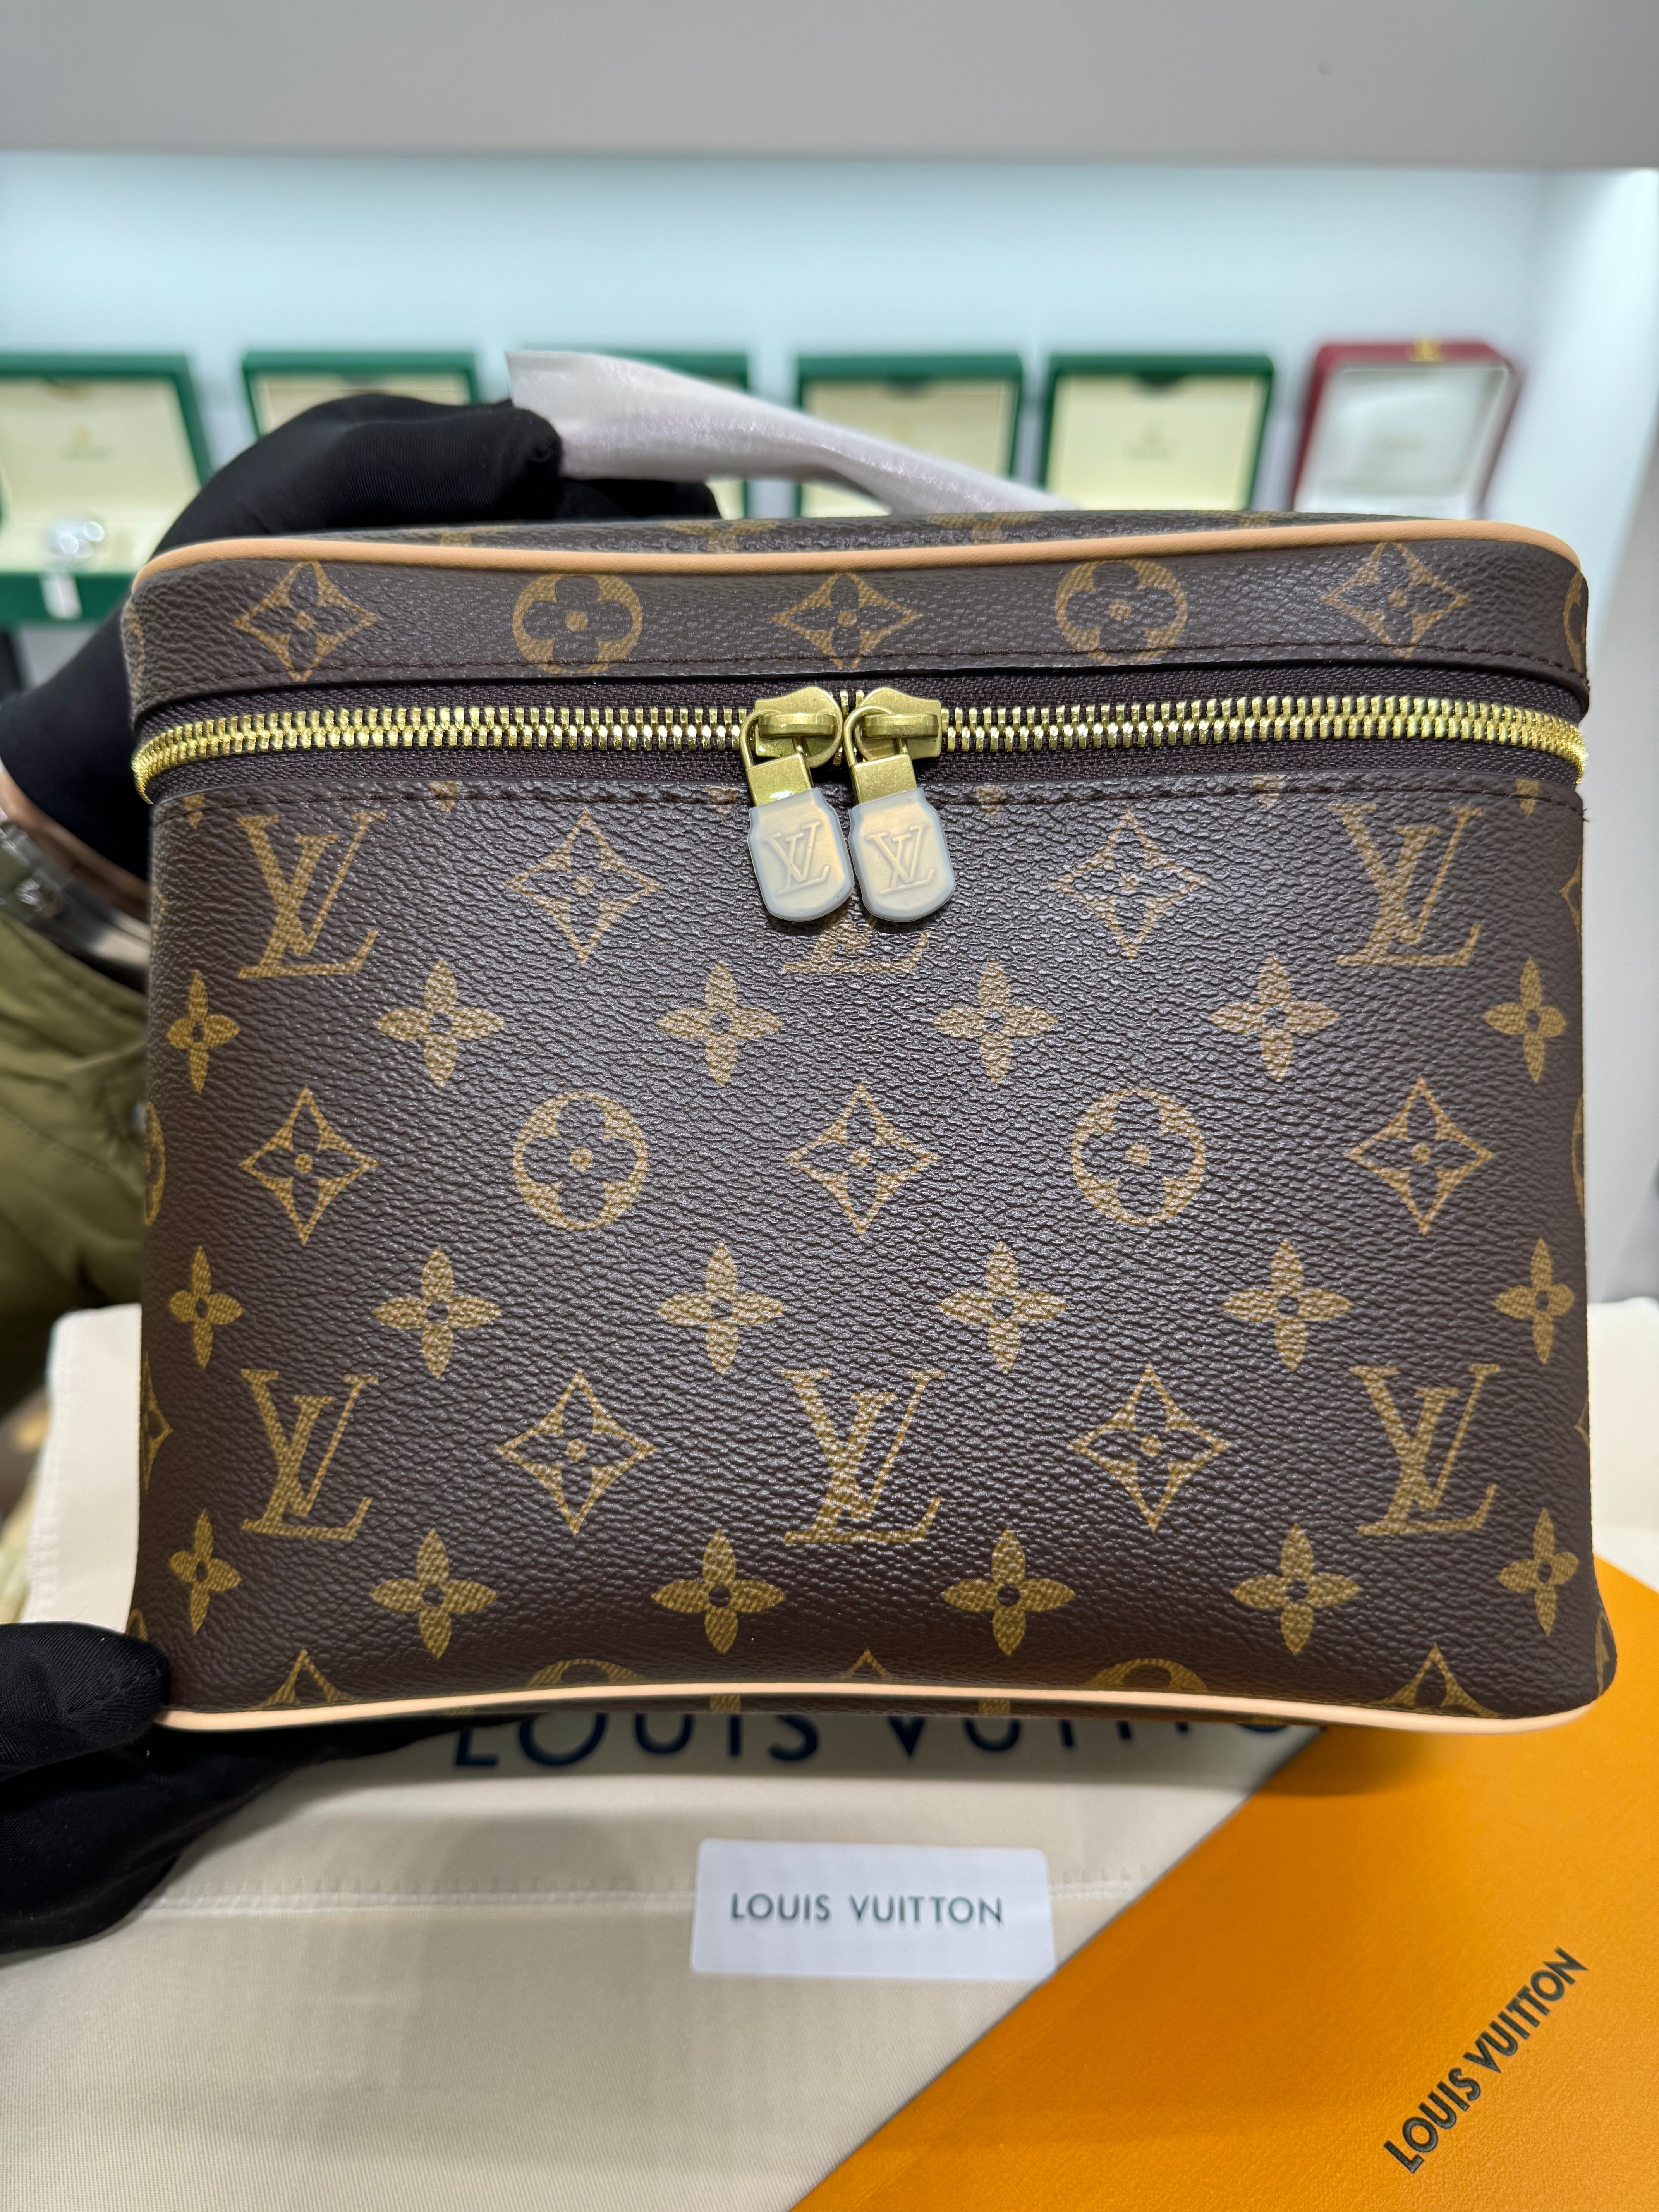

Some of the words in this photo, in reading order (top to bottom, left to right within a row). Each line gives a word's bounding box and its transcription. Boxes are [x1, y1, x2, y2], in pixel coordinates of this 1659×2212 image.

[237, 811, 386, 979] LV
[766, 820, 831, 895] LV
[864, 823, 937, 895] LV
[1328, 802, 1483, 966] LV
[241, 1368, 379, 1540] LV
[781, 1369, 945, 1543] LV
[1350, 1364, 1501, 1536] LV
[730, 1892, 831, 1922] LOUIS
[850, 1894, 1004, 1925] VUITTON
[1383, 2067, 1482, 2174] LOUIS
[1463, 1946, 1589, 2074] VUITTON
